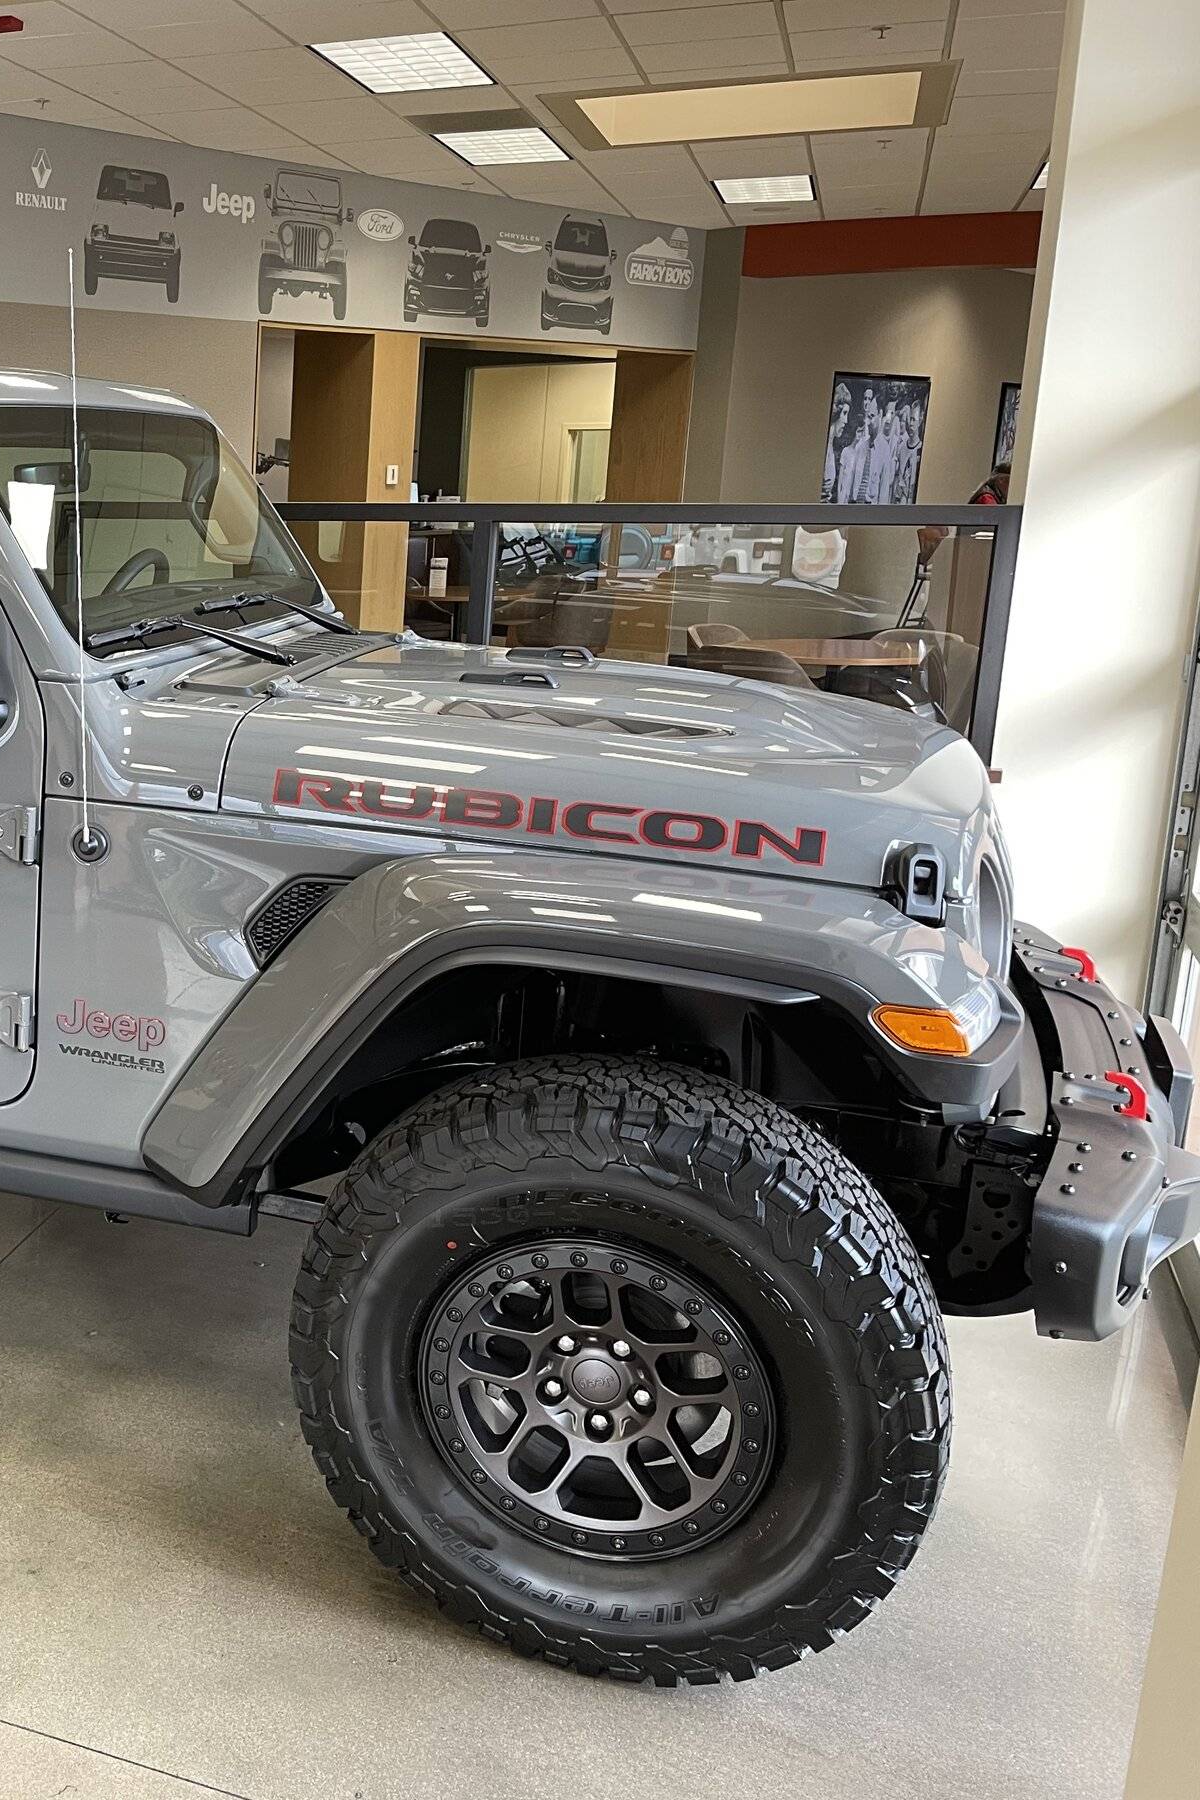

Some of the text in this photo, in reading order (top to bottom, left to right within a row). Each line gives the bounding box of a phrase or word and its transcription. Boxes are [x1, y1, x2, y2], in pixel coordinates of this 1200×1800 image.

[15, 191, 67, 211] RENAULT
[203, 183, 255, 224] Jeep
[367, 213, 395, 235] Ford
[499, 231, 540, 242] CHRYSLER
[664, 266, 692, 285] BOYS
[273, 768, 826, 866] RUBICON
[56, 999, 166, 1051] Jeep
[59, 1043, 165, 1069] WRANGLER
[91, 1058, 165, 1074] UNLIMITED
